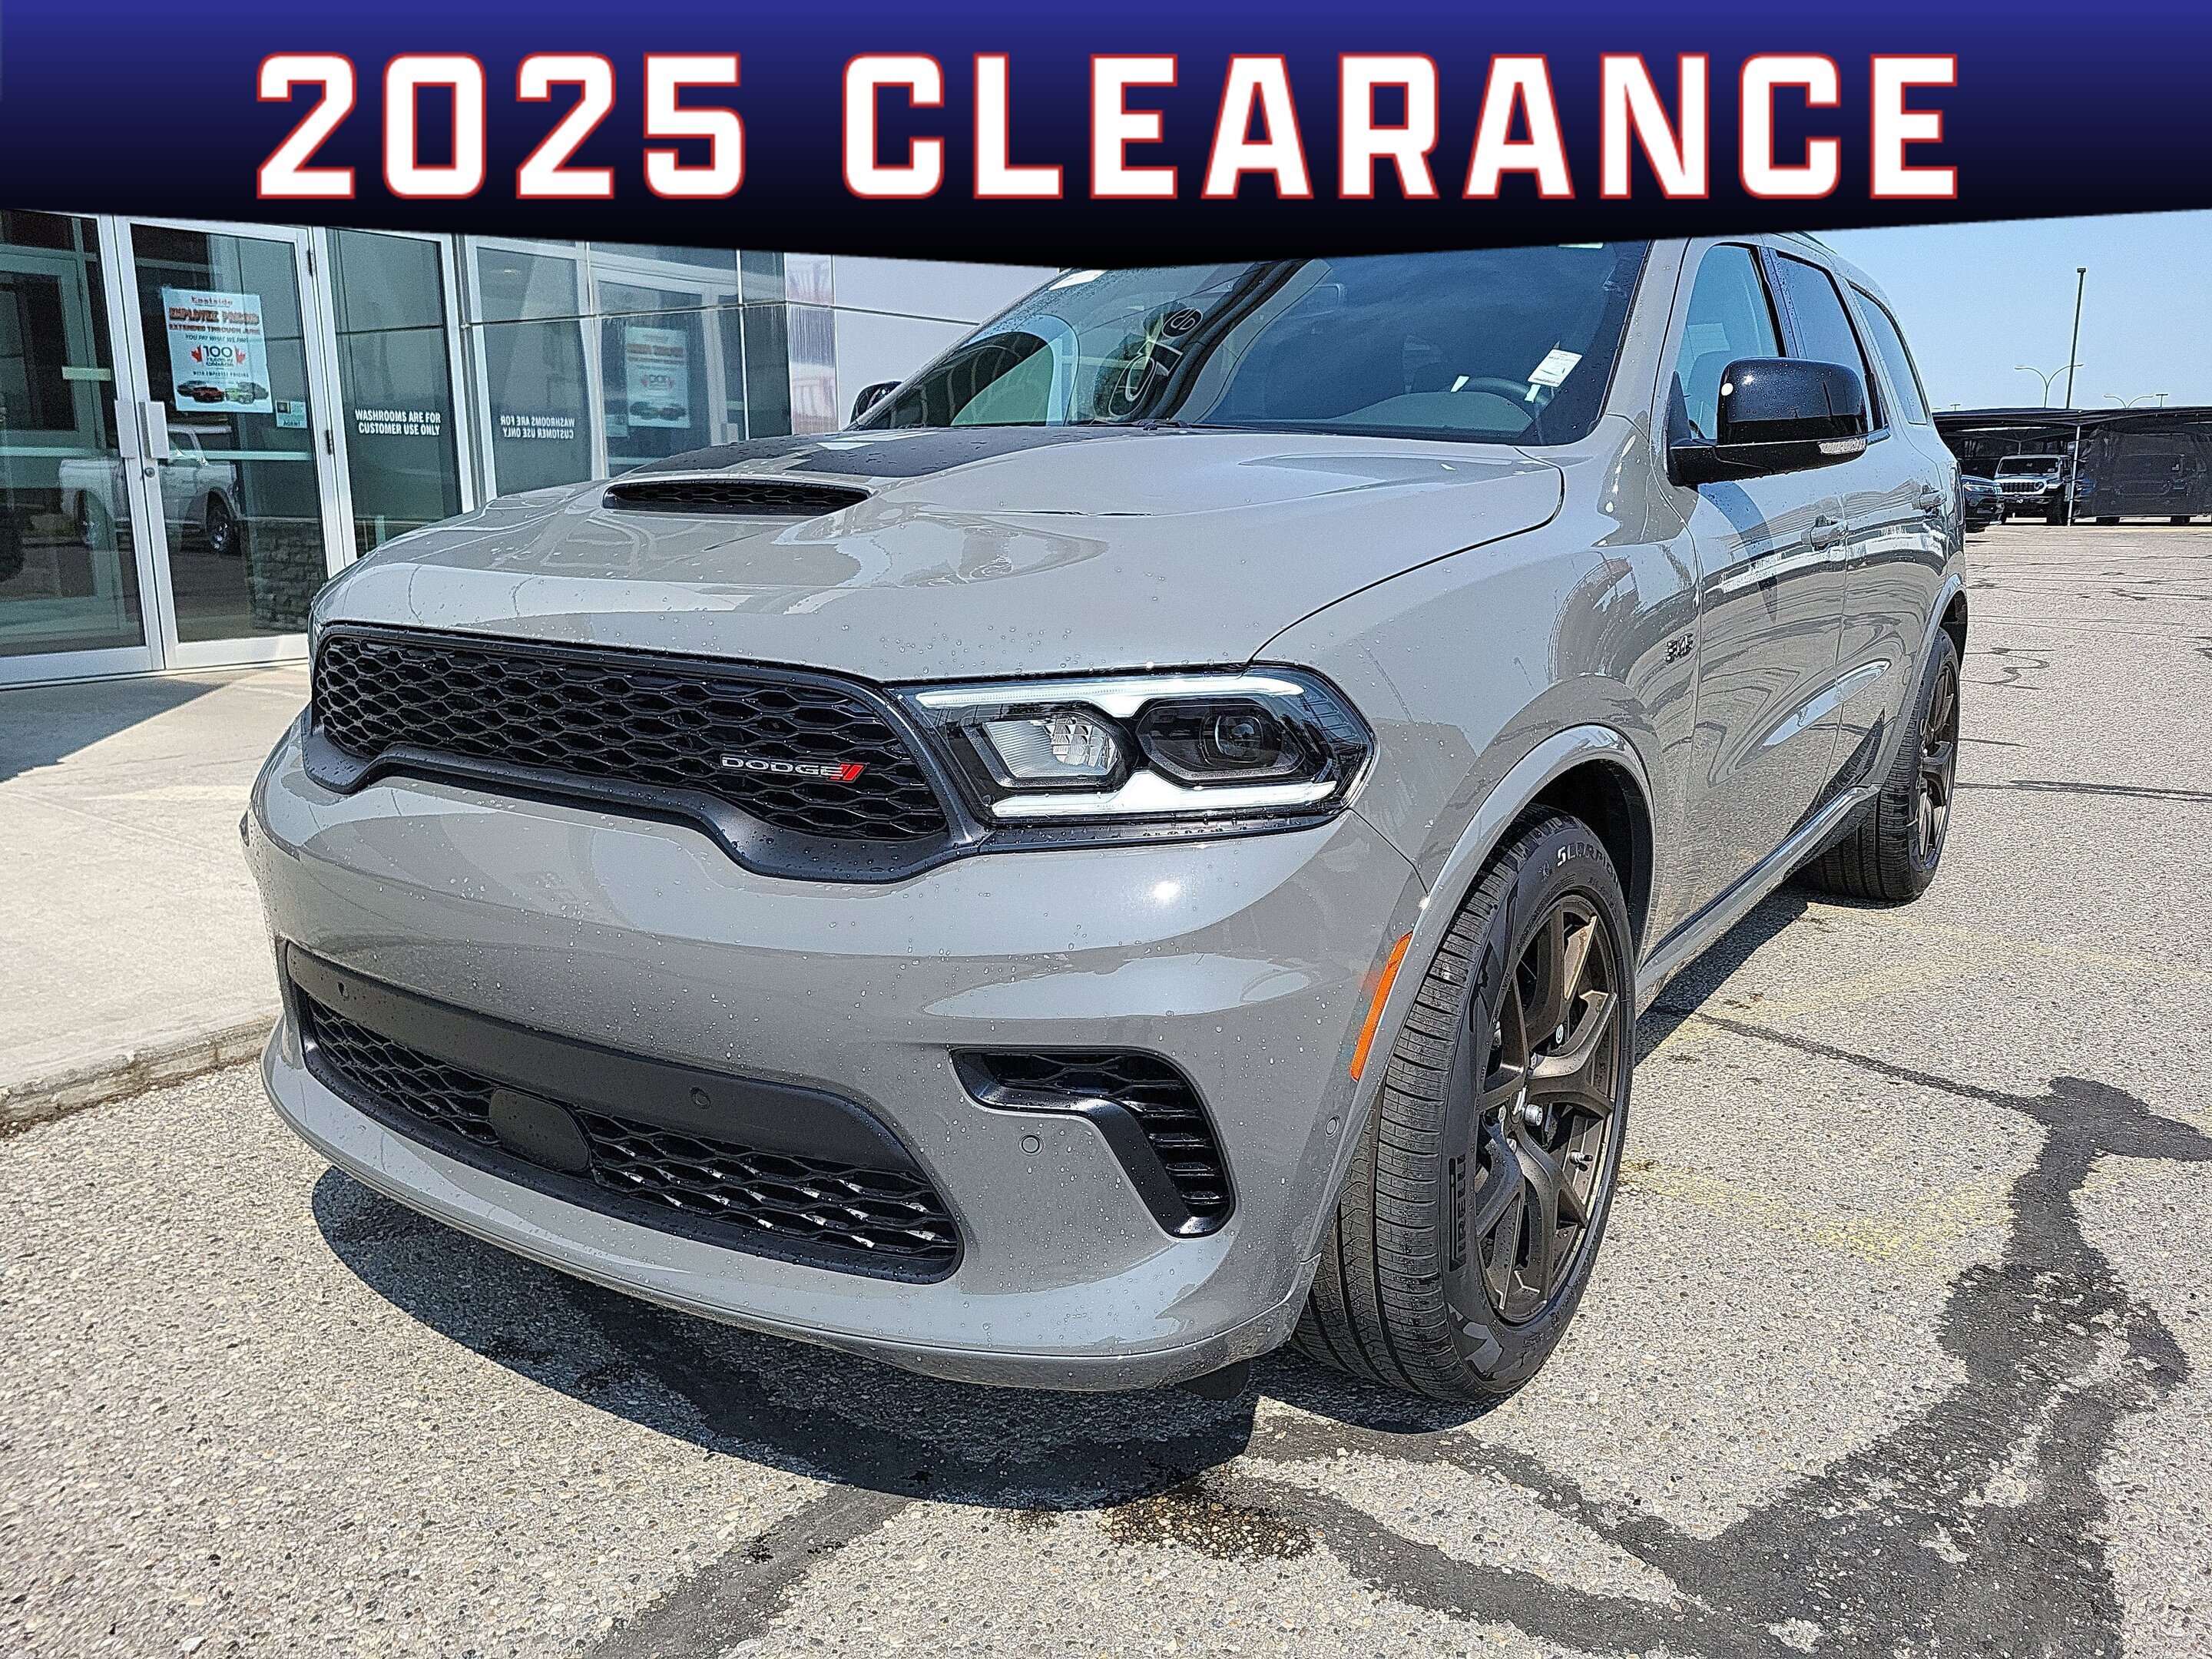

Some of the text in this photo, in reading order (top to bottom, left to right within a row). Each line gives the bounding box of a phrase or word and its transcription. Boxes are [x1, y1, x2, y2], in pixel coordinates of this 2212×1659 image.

[203, 345, 233, 357] 100
[355, 409, 441, 424] WASHROOMS ARE FOR
[358, 422, 440, 435] CUSTOMER USE ONLY
[721, 757, 844, 778] DODGE
